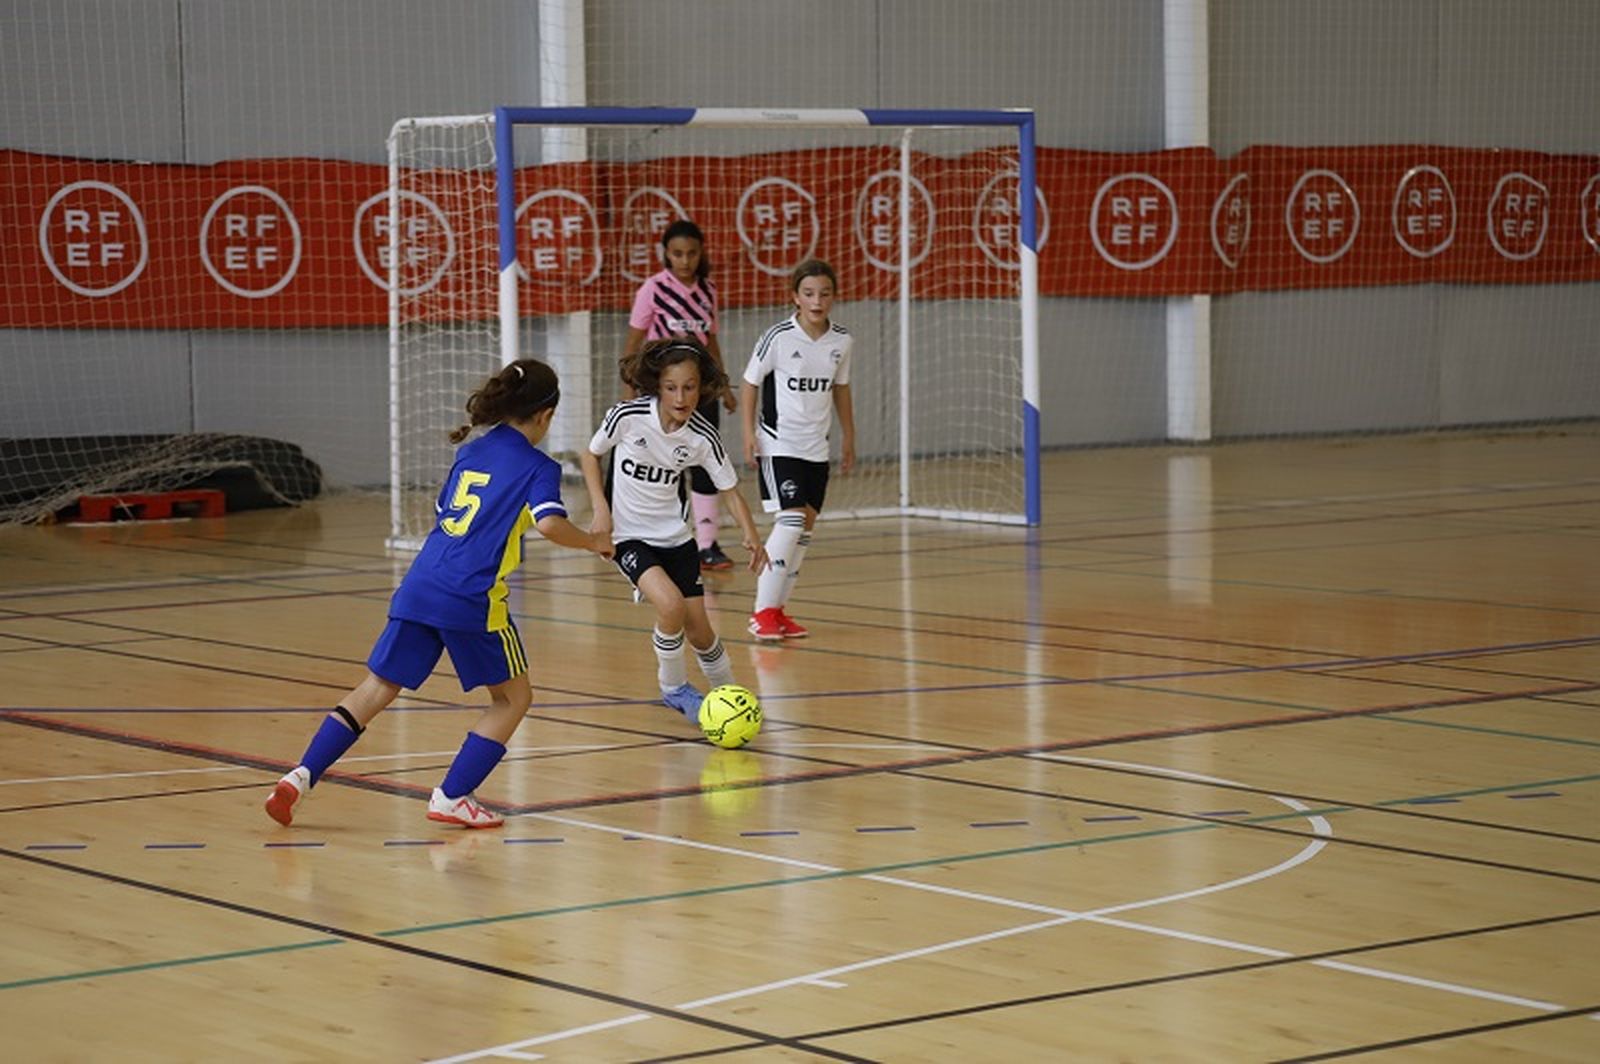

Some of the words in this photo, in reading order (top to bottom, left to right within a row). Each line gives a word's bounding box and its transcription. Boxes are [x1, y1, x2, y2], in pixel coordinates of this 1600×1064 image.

[1111, 197, 1159, 218] RF
[1304, 193, 1342, 212] RF
[1408, 188, 1443, 208] RF
[1506, 195, 1539, 213] RF
[66, 209, 121, 234] RF
[226, 215, 278, 237] RF
[532, 217, 583, 240] RF
[1303, 220, 1345, 240] EF
[1408, 215, 1443, 236] EF
[1503, 219, 1535, 238] EF
[1111, 225, 1158, 246] EF
[67, 244, 125, 267] EF
[226, 247, 278, 269] EF
[534, 248, 583, 270] EF
[439, 470, 491, 538] 5
